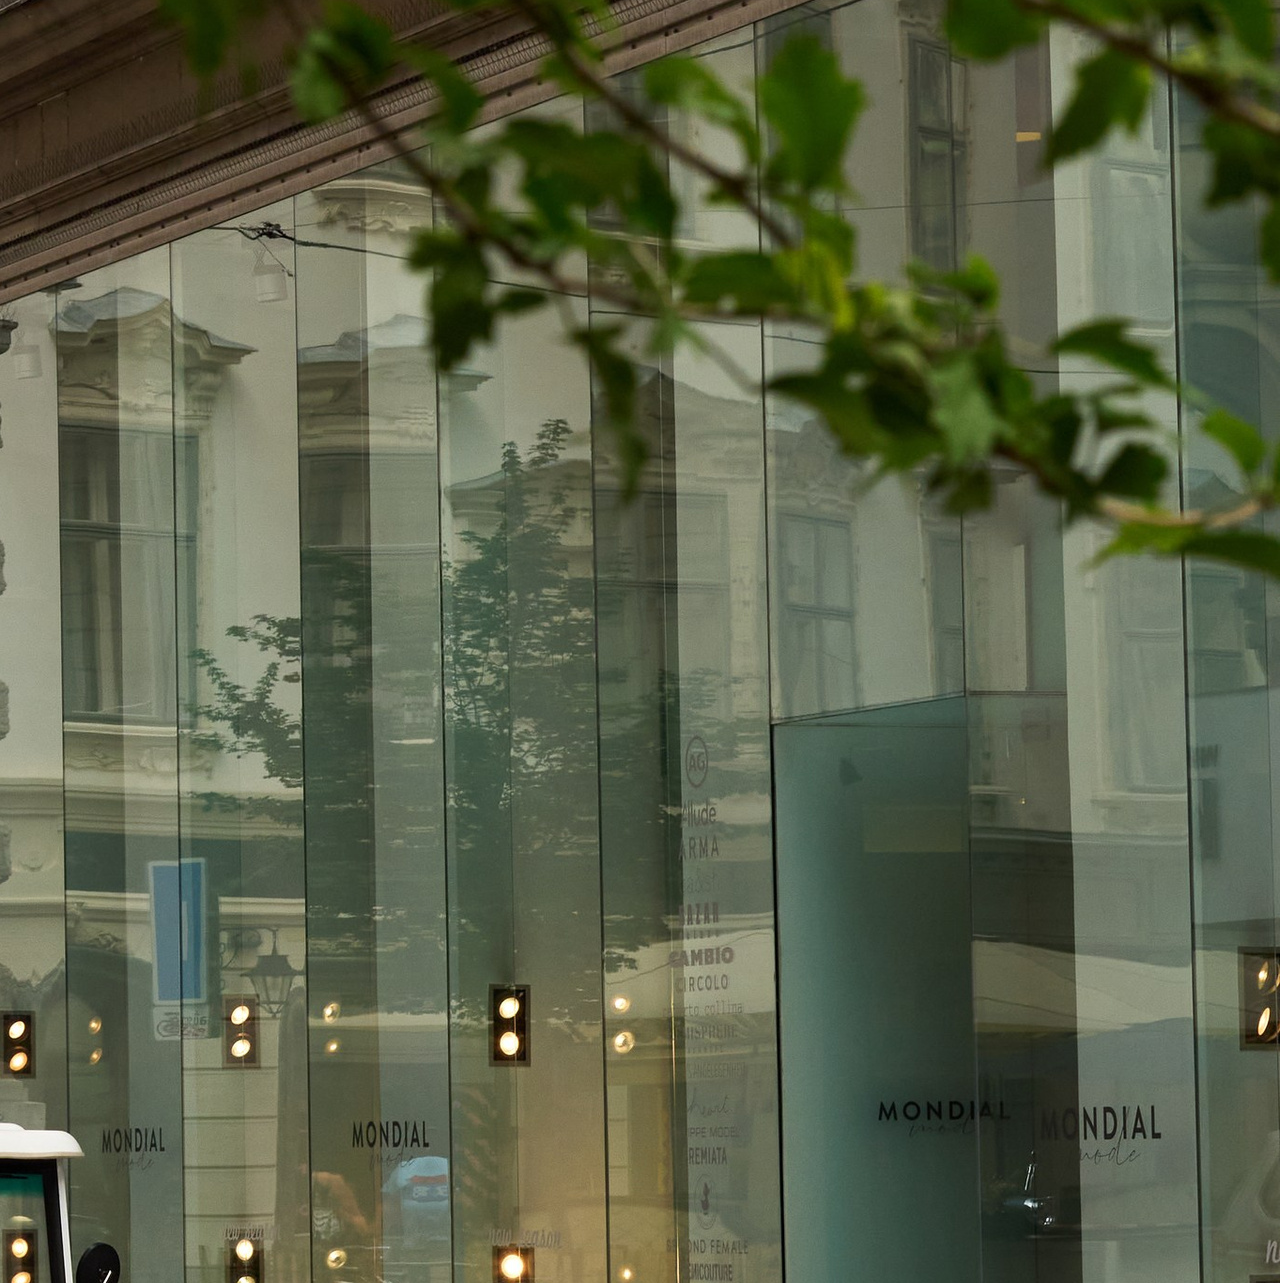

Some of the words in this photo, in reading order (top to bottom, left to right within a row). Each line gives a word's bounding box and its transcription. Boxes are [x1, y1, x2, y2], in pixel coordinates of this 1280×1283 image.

[669, 947, 736, 968] CAMBIO
[878, 1100, 1011, 1121] MONDIAL
[1041, 1105, 1162, 1140] MONDIAL
[101, 1126, 166, 1154] MONDIAL
[352, 1120, 430, 1148] MONDIAL
[688, 1147, 728, 1166] REMIATA
[710, 1239, 749, 1255] FEMALE
